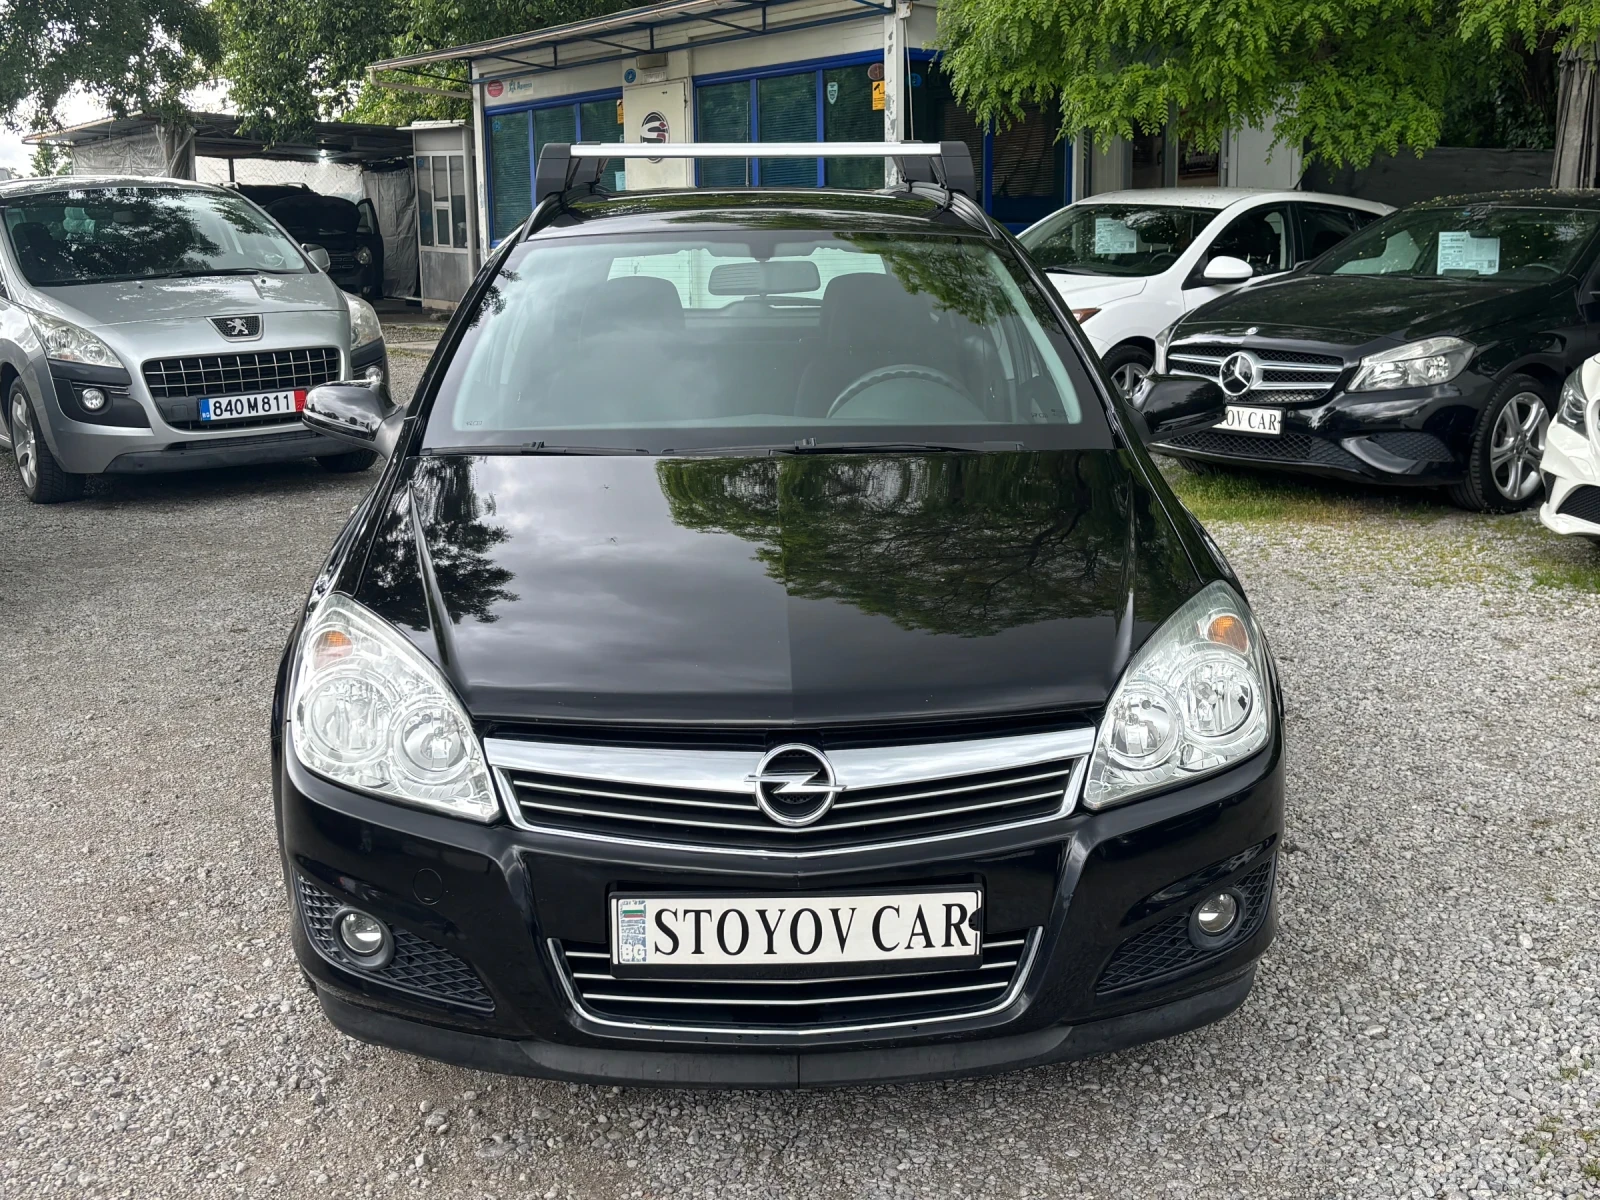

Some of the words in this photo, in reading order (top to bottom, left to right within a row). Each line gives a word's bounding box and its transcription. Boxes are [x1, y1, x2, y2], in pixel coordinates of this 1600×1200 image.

[1248, 411, 1277, 431] CAR
[654, 907, 858, 956] STOYOV
[872, 902, 972, 952] CAR
[621, 943, 646, 960] BG
